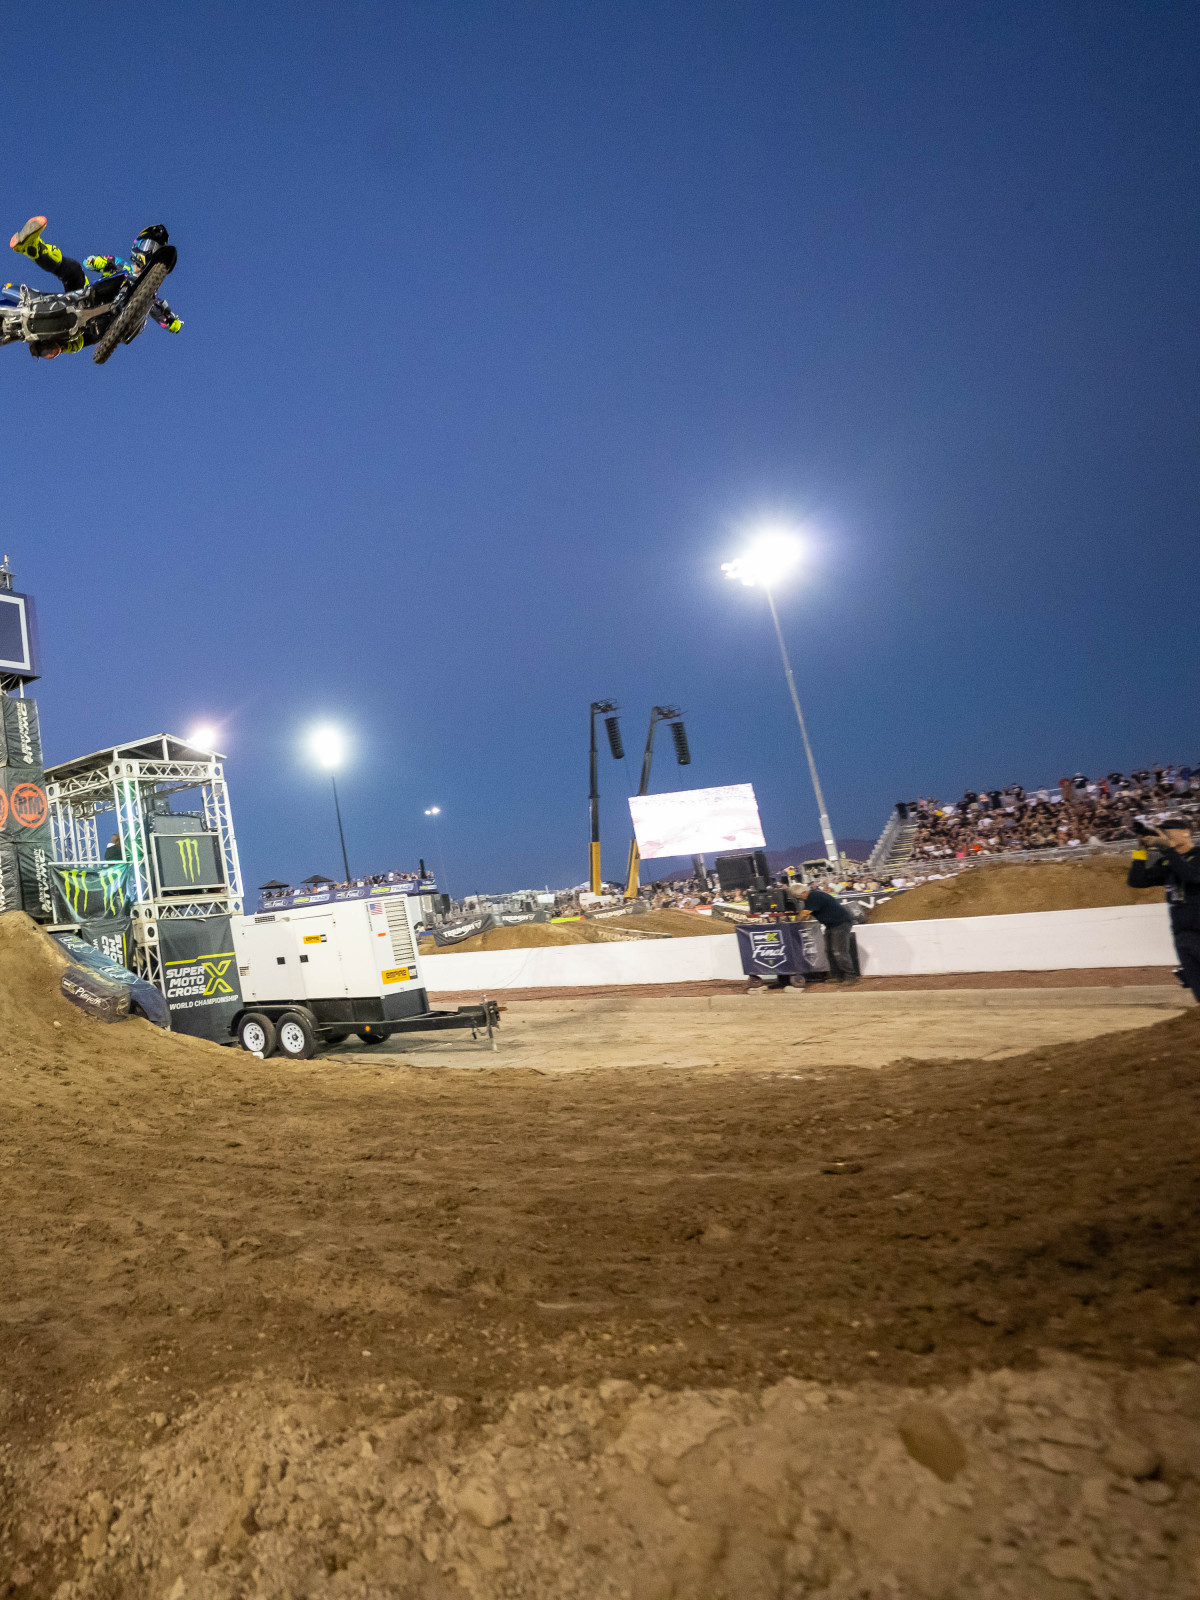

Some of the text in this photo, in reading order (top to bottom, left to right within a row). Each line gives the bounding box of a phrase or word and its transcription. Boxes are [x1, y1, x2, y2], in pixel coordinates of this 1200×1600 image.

[166, 966, 205, 979] SUPER
[169, 975, 204, 988] MOTO
[167, 985, 206, 998] CROSS
[169, 995, 239, 1011] WORLD CHAMPIONSHIP
